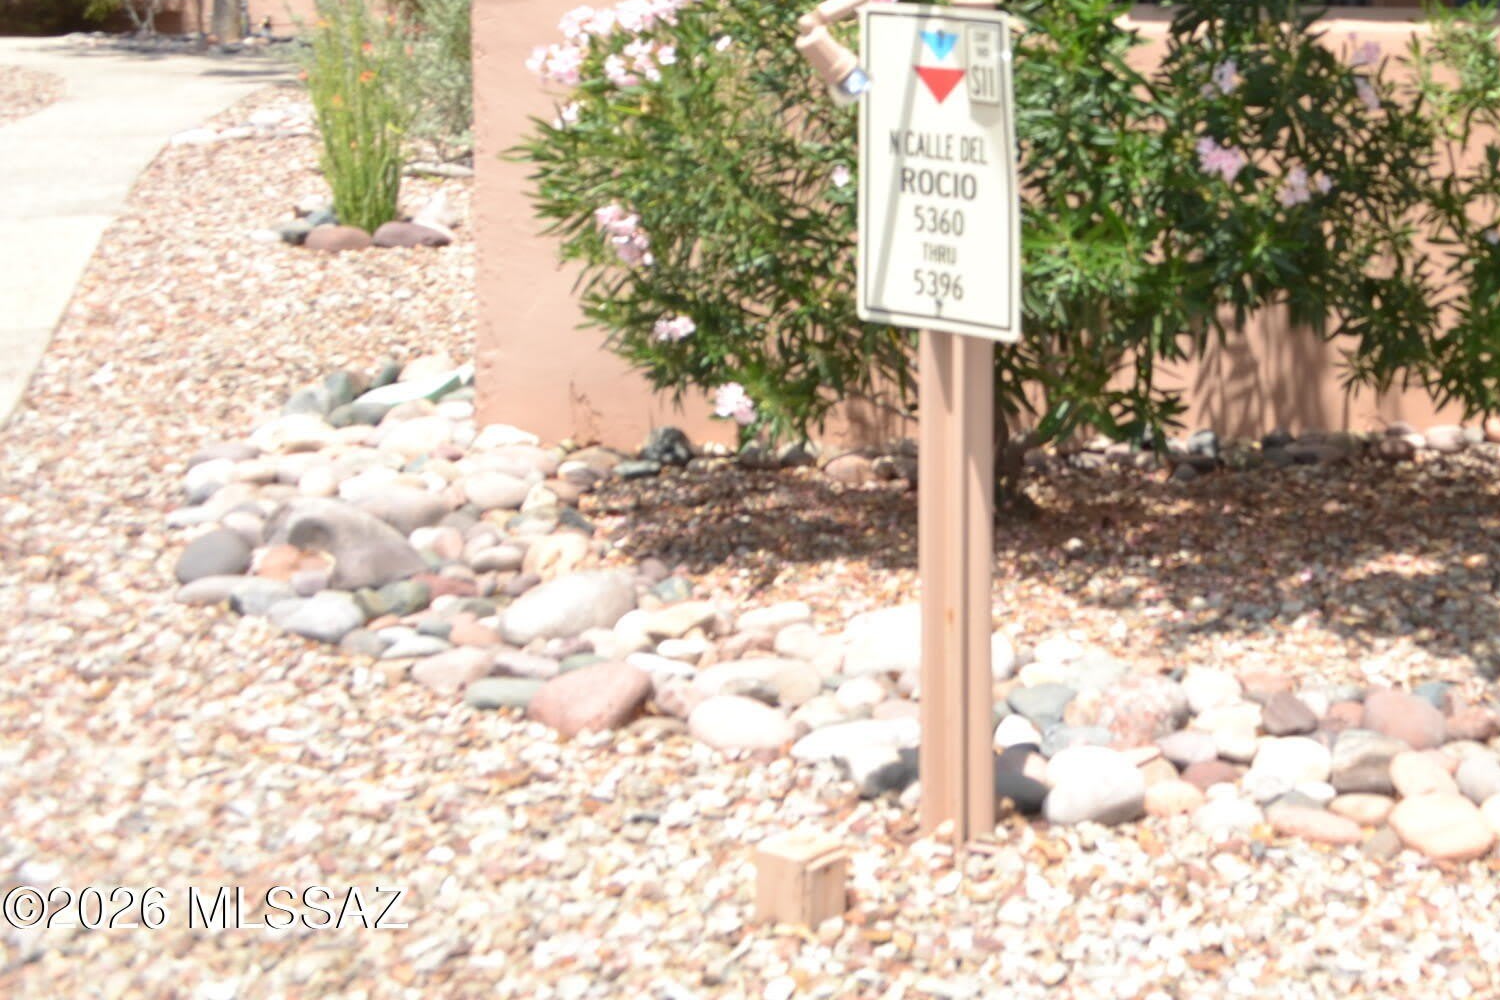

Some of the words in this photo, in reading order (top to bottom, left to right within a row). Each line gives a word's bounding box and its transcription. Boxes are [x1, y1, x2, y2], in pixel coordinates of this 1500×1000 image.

[889, 129, 901, 155] N
[904, 130, 953, 162] CALLE
[960, 135, 988, 165] DEL
[900, 167, 977, 201] ROCIO
[913, 205, 965, 237] 5360
[922, 242, 957, 265] THRU
[913, 268, 964, 301] 5396
